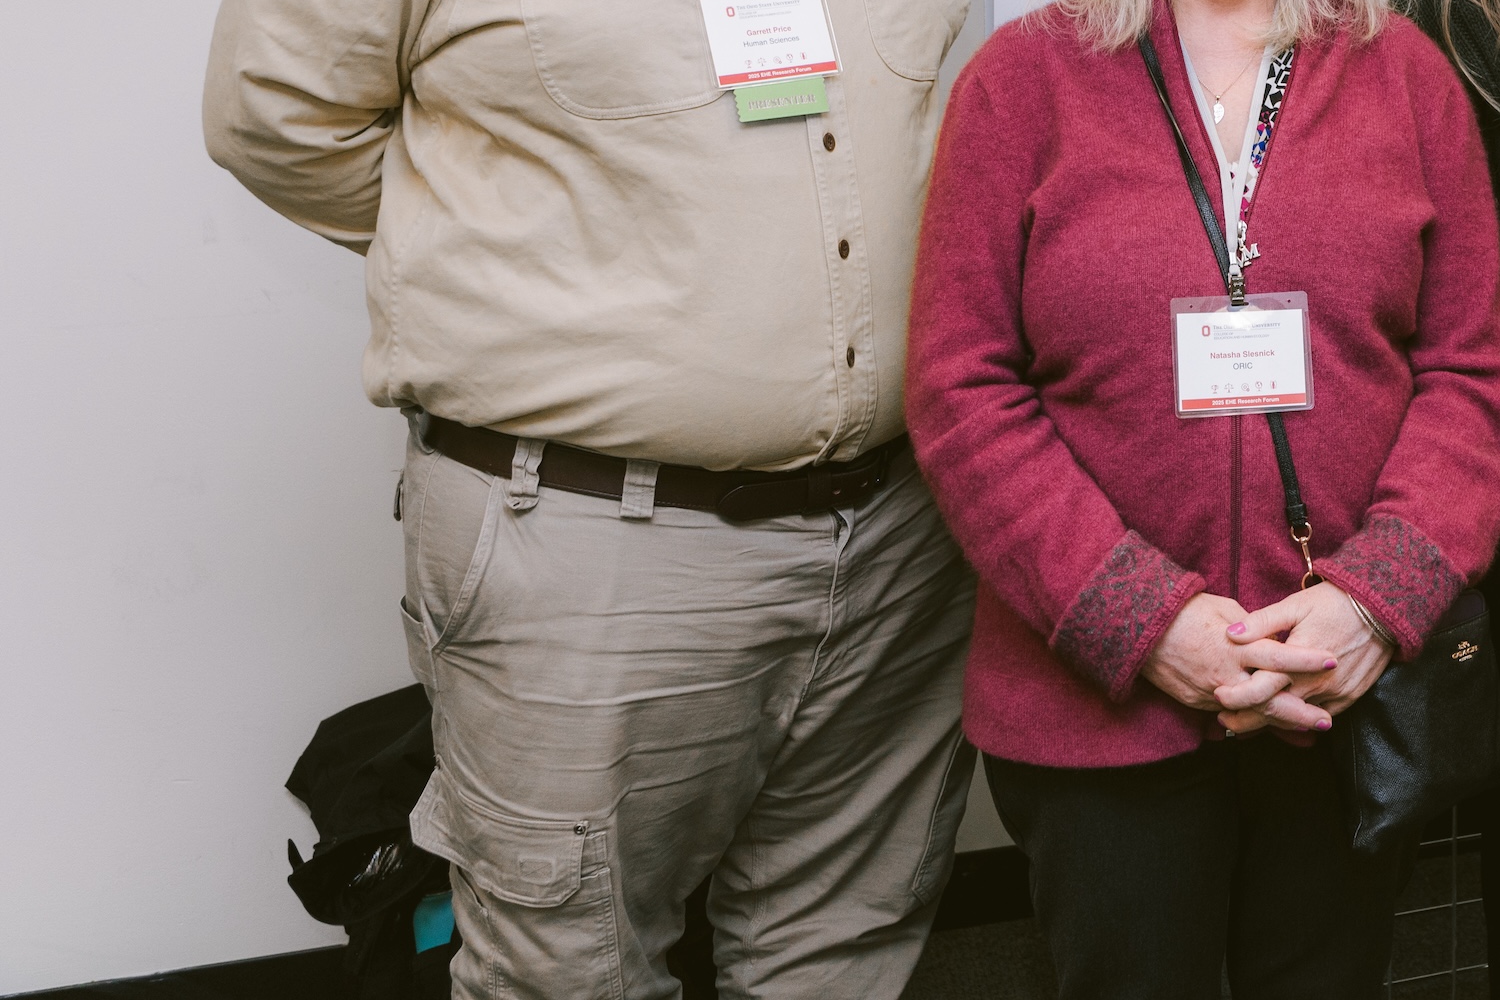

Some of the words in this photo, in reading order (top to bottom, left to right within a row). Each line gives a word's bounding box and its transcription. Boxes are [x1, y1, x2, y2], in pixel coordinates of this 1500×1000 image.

[747, 28, 771, 36] Garrett
[743, 40, 767, 48] Human
[770, 36, 800, 44] Sciences
[748, 94, 816, 110] PRESENTER
[1243, 349, 1275, 357] Slesnick
[1233, 362, 1252, 370] ORIC
